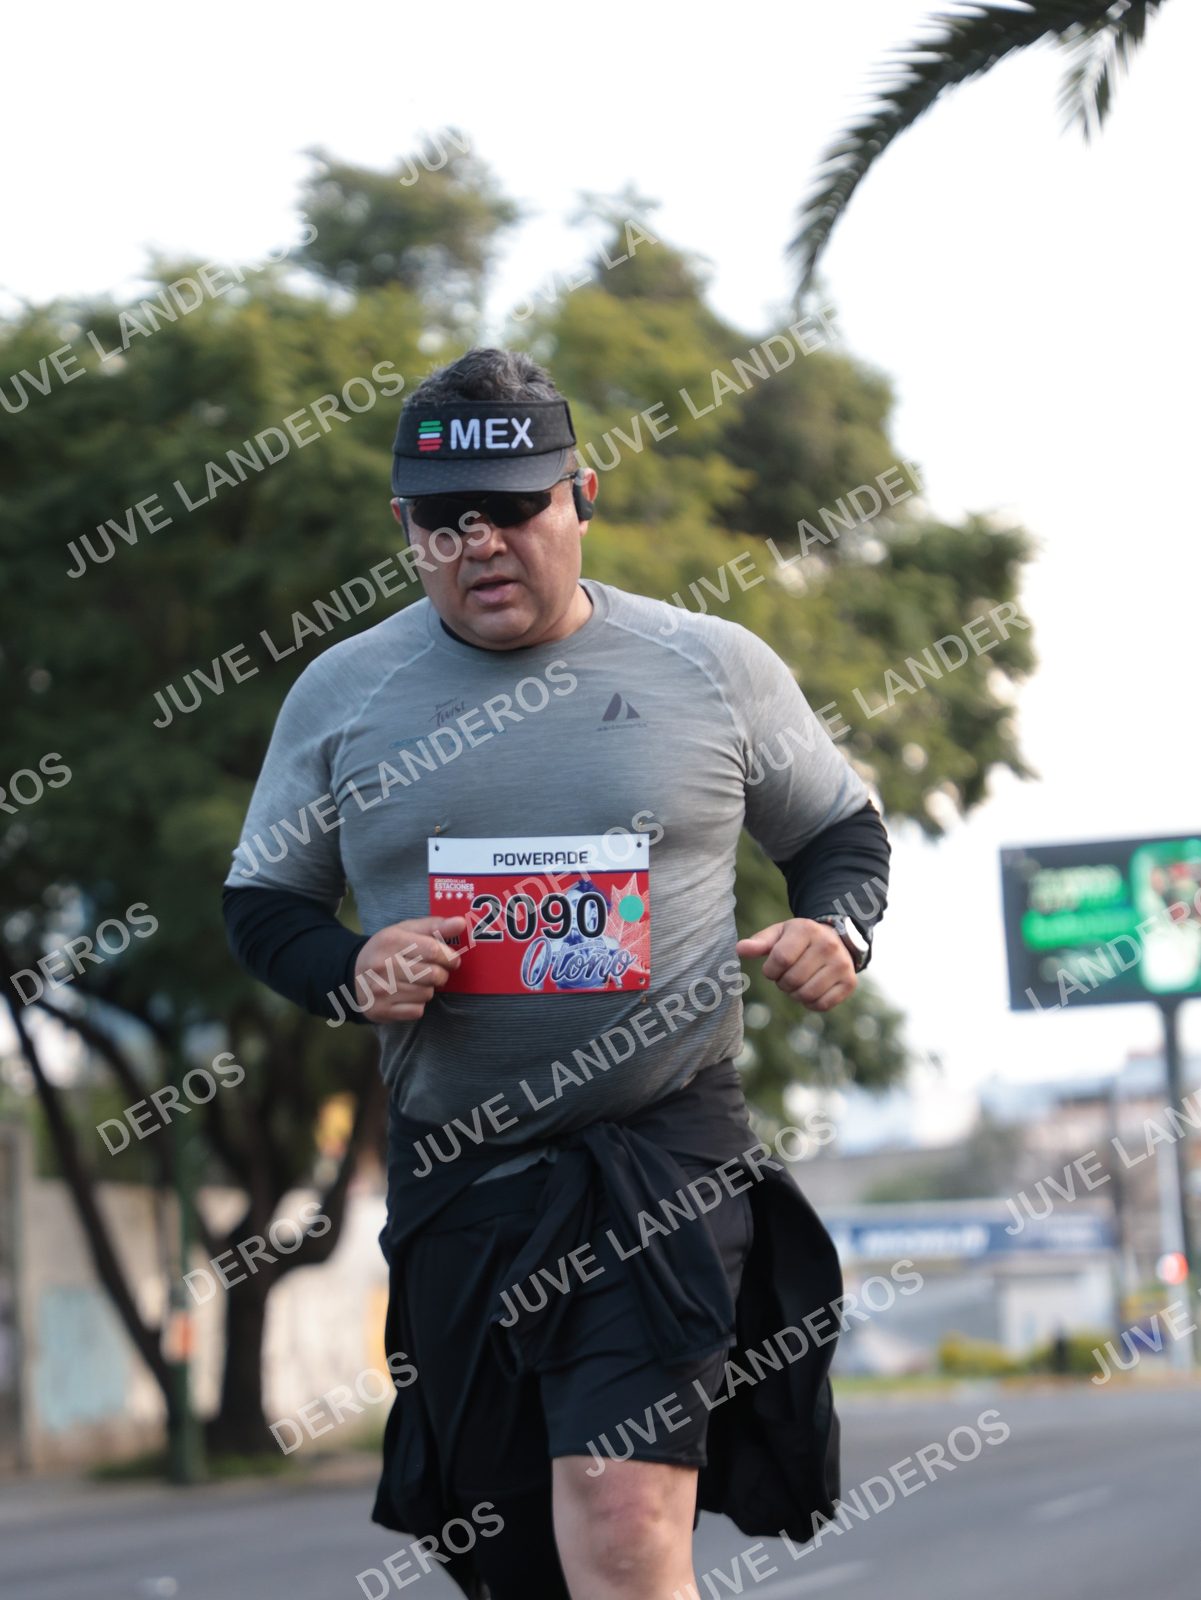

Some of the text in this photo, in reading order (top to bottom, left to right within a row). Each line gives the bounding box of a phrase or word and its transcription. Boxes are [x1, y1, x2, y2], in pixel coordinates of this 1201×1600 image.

[449, 417, 535, 452] MEX
[493, 850, 589, 867] POWERADE
[471, 891, 608, 942] 2090
